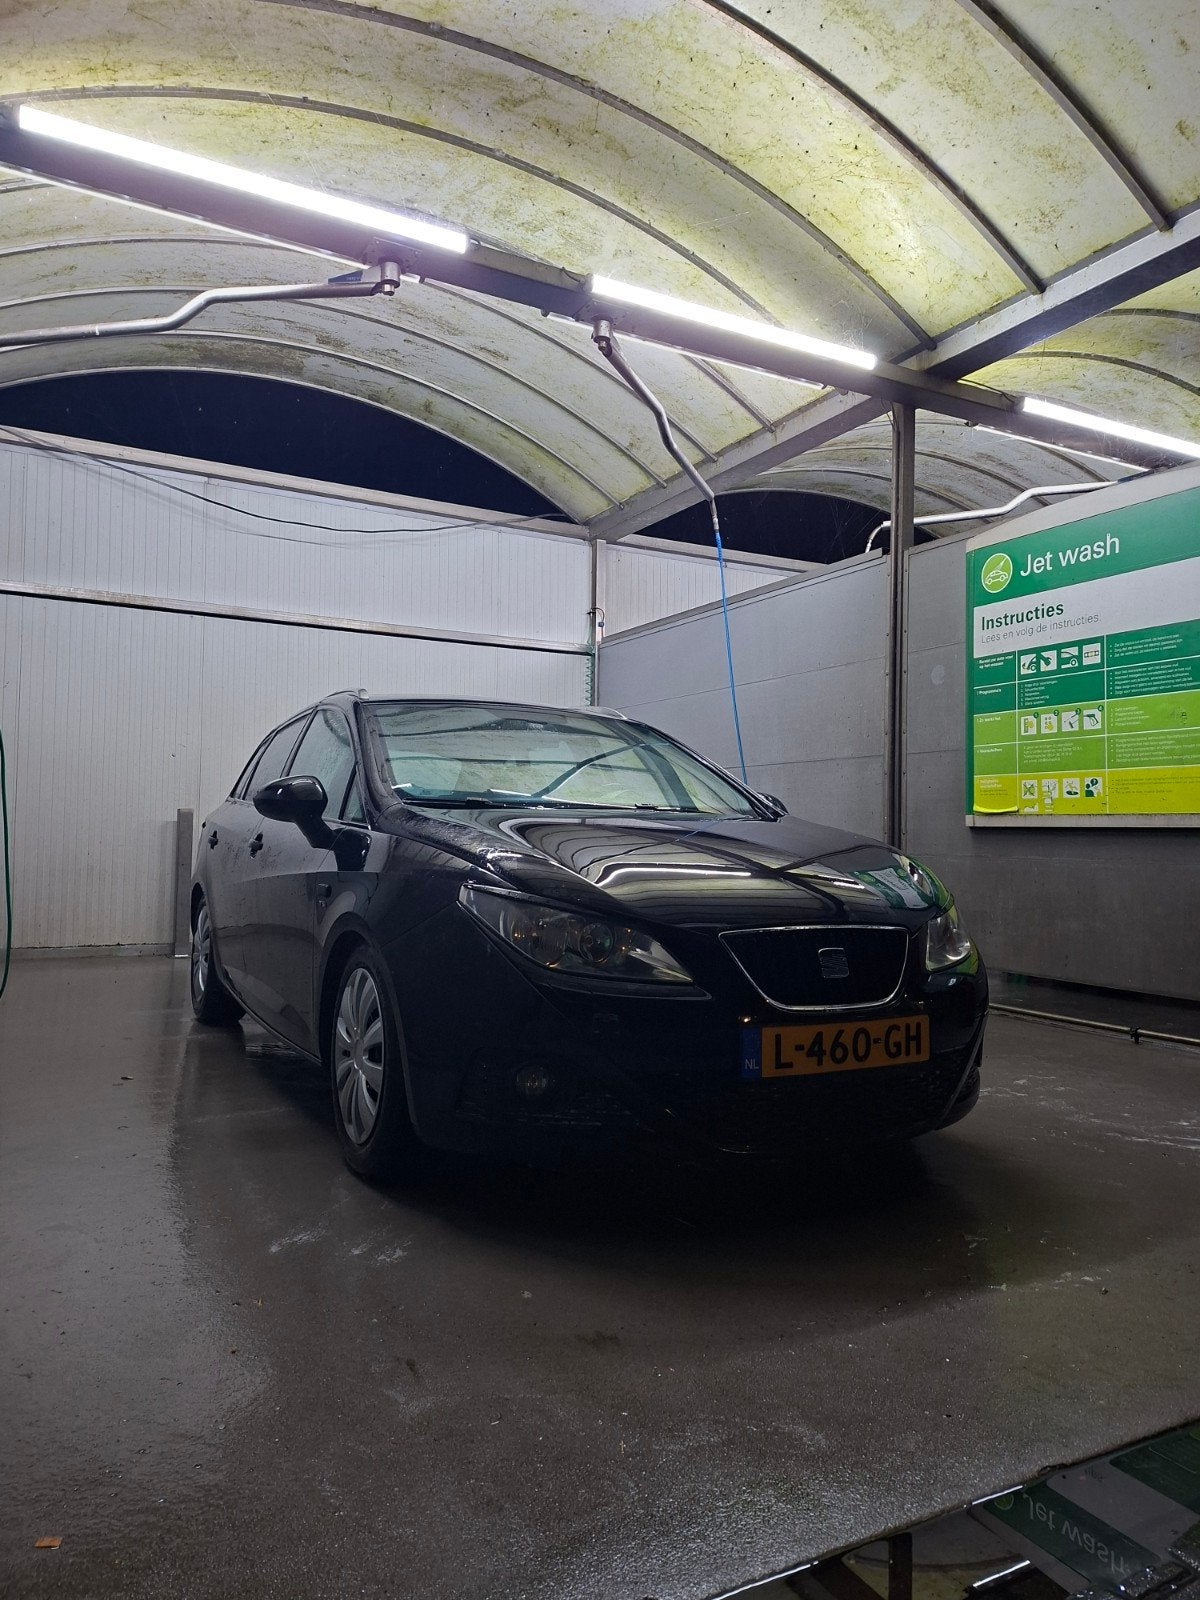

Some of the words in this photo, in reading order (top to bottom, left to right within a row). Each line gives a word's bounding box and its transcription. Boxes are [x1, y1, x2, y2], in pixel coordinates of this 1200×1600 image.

[1020, 551, 1053, 577] Jet
[1058, 533, 1120, 568] wash
[981, 603, 1064, 631] Instructies
[981, 632, 1001, 644] Lees
[1002, 631, 1014, 640] en
[1016, 625, 1034, 639] volg
[1036, 622, 1048, 633] de
[744, 1058, 760, 1070] NL
[774, 1021, 922, 1070] L-460-GH
